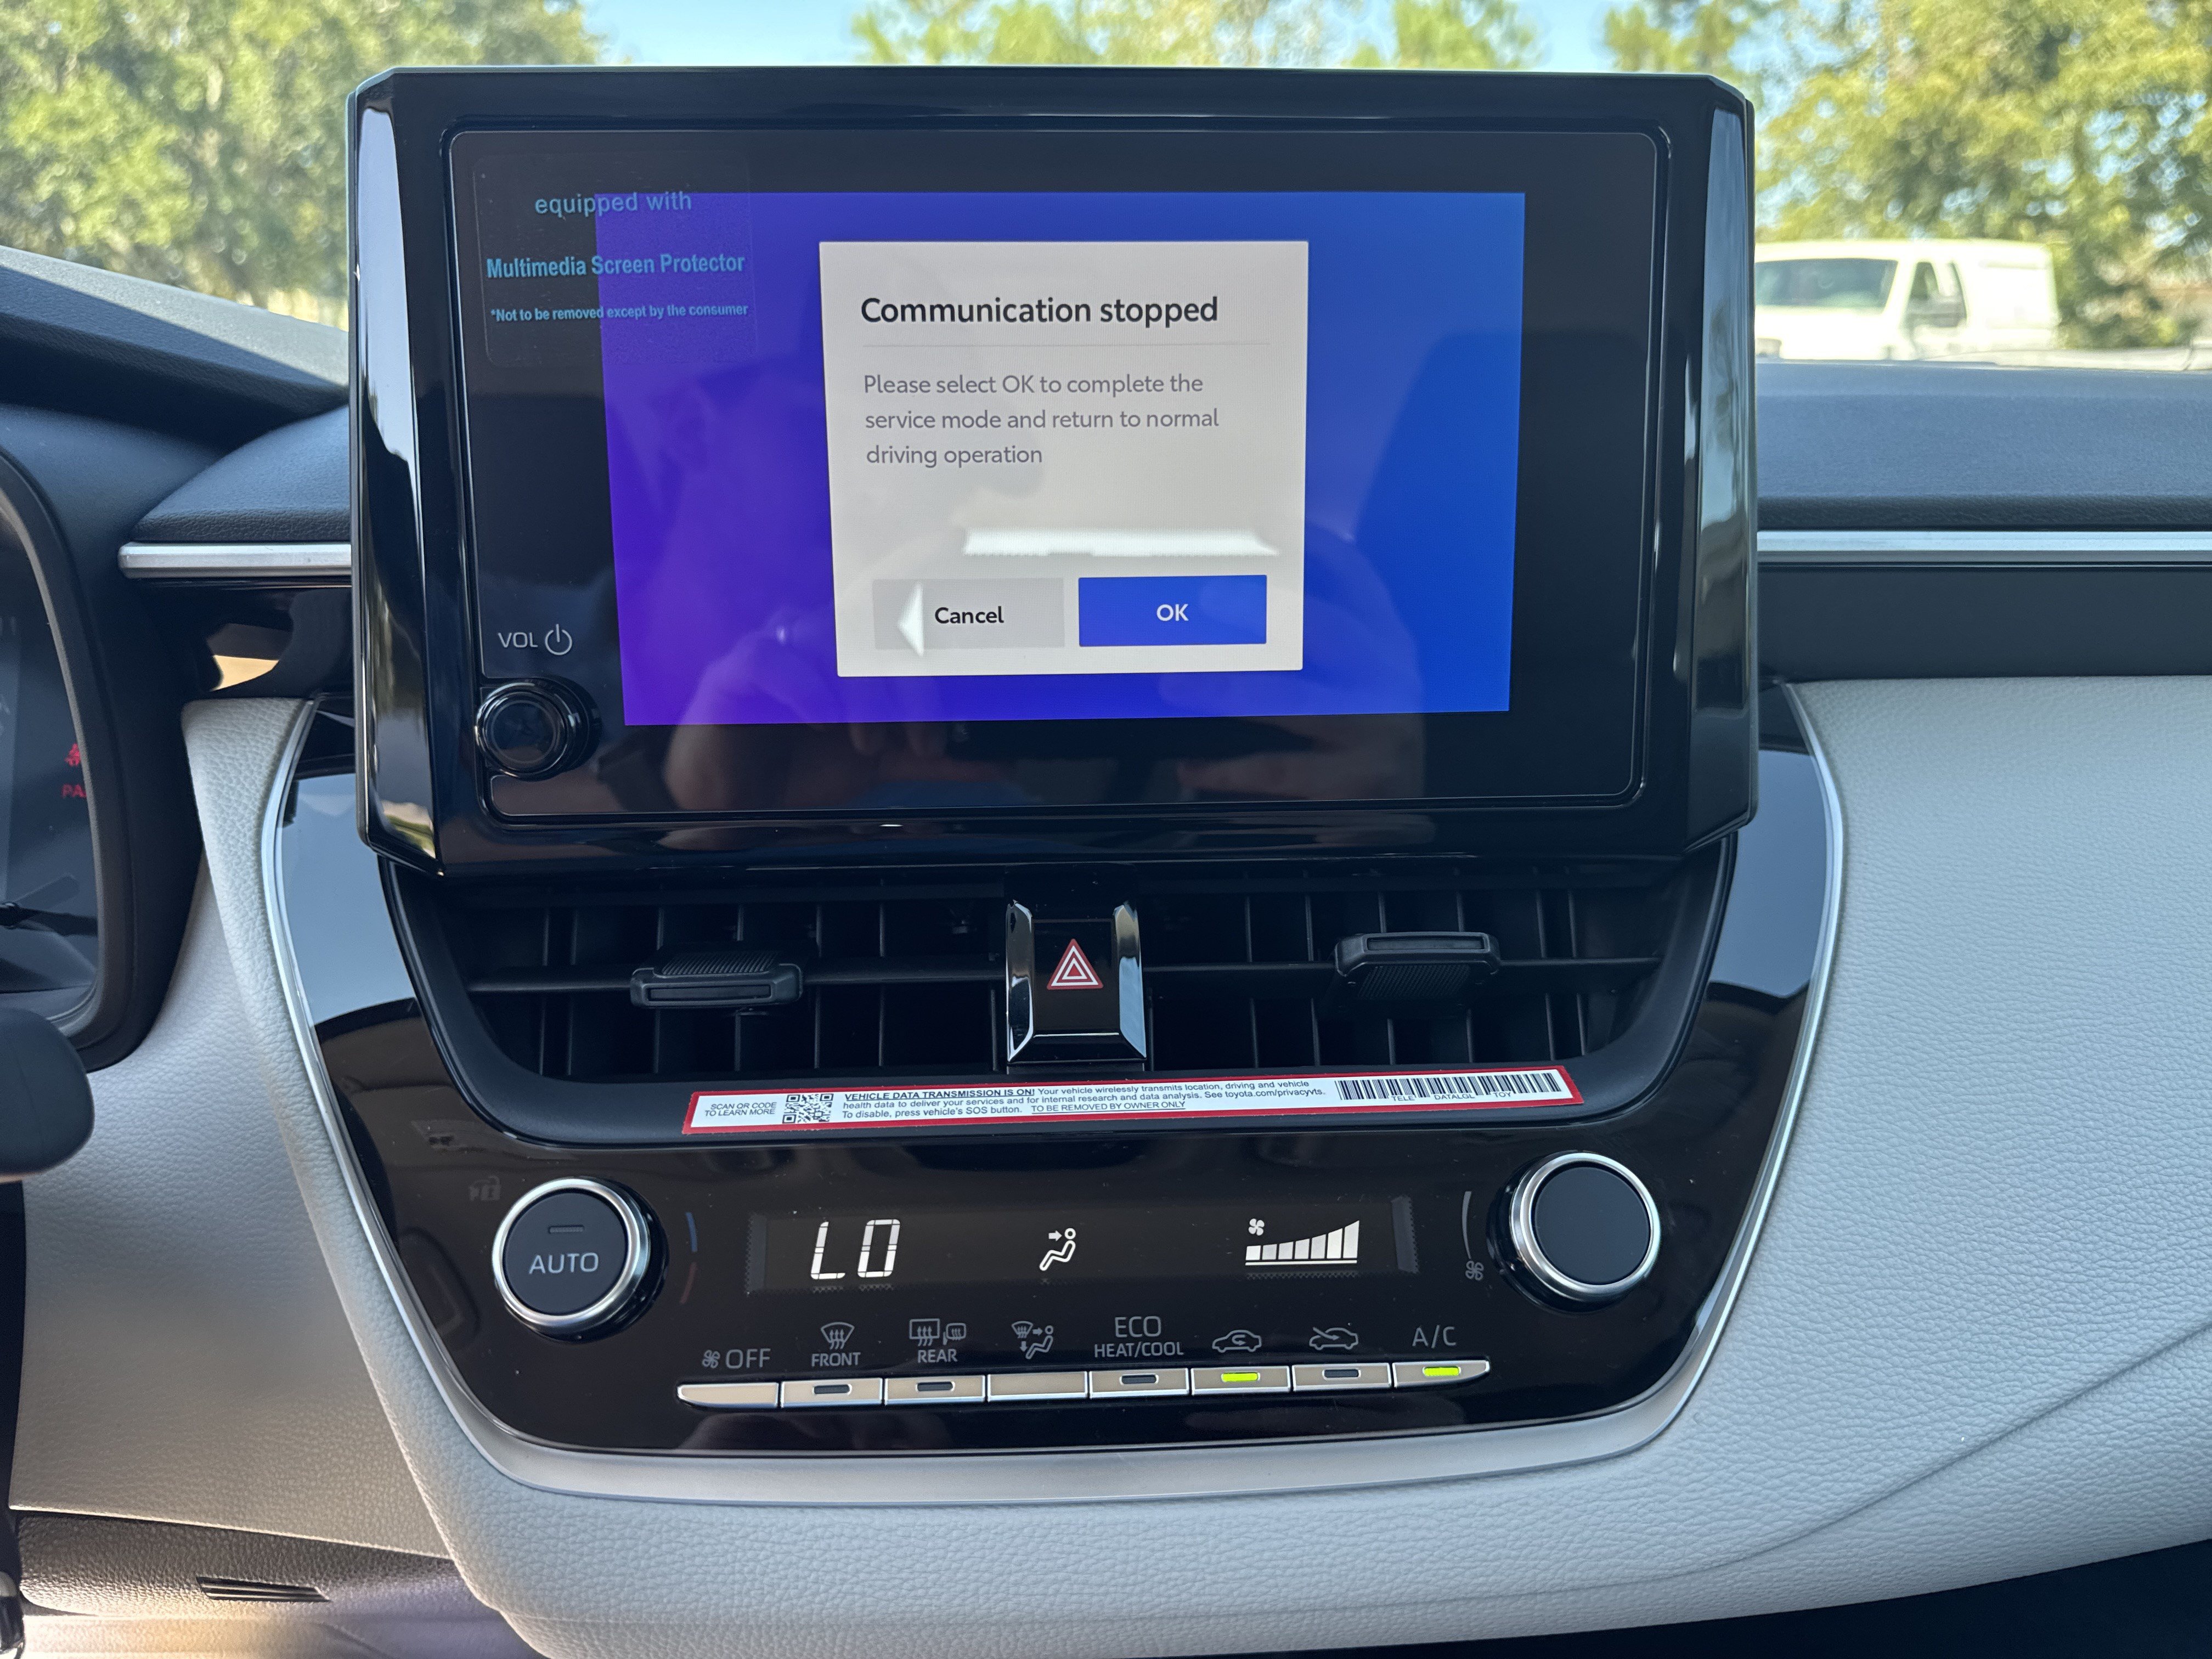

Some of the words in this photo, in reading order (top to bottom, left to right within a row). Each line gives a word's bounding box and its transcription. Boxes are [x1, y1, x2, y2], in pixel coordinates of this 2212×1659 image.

[534, 192, 639, 218] equipped
[646, 191, 692, 210] with
[487, 256, 587, 279] Multimedia
[591, 255, 655, 274] Screen
[660, 253, 745, 273] Protector
[520, 308, 532, 320] to
[534, 307, 550, 320] be
[552, 307, 603, 320] removed
[607, 306, 647, 321] except
[649, 305, 665, 320] by
[667, 304, 686, 317] the
[689, 304, 748, 317] consumer
[860, 297, 1091, 325] Communication
[1100, 297, 1218, 328] stopped
[864, 375, 931, 393] Please
[936, 375, 997, 393] select
[1002, 375, 1035, 393] OK
[1041, 377, 1062, 393] to
[1067, 374, 1164, 398] complete
[1170, 374, 1203, 393] the
[865, 411, 935, 430] service
[942, 410, 1001, 428] mode
[1007, 410, 1046, 428] and
[1052, 412, 1113, 428] return
[1120, 412, 1141, 428] to
[1146, 409, 1218, 428] normal
[866, 445, 938, 469] driving
[943, 446, 1042, 469] operation
[934, 606, 1004, 625] Cancel
[1156, 603, 1189, 622] OK
[498, 632, 538, 648] VOL
[922, 1090, 1001, 1098] TRANSMISSION
[1225, 1082, 1255, 1090] driving
[943, 1099, 963, 1108] your
[1163, 1092, 1202, 1101] analysis.
[855, 1109, 892, 1118] disable,
[895, 1110, 921, 1118] press
[923, 1108, 963, 1116] vehicle's
[529, 1252, 599, 1275] AUTO
[1115, 1316, 1161, 1338] ECO
[1412, 1325, 1457, 1348] A/C
[726, 1348, 771, 1369] OFF
[811, 1351, 861, 1368] FRONT
[917, 1349, 958, 1363] REAR
[1094, 1342, 1184, 1358] HEAT/COOL
